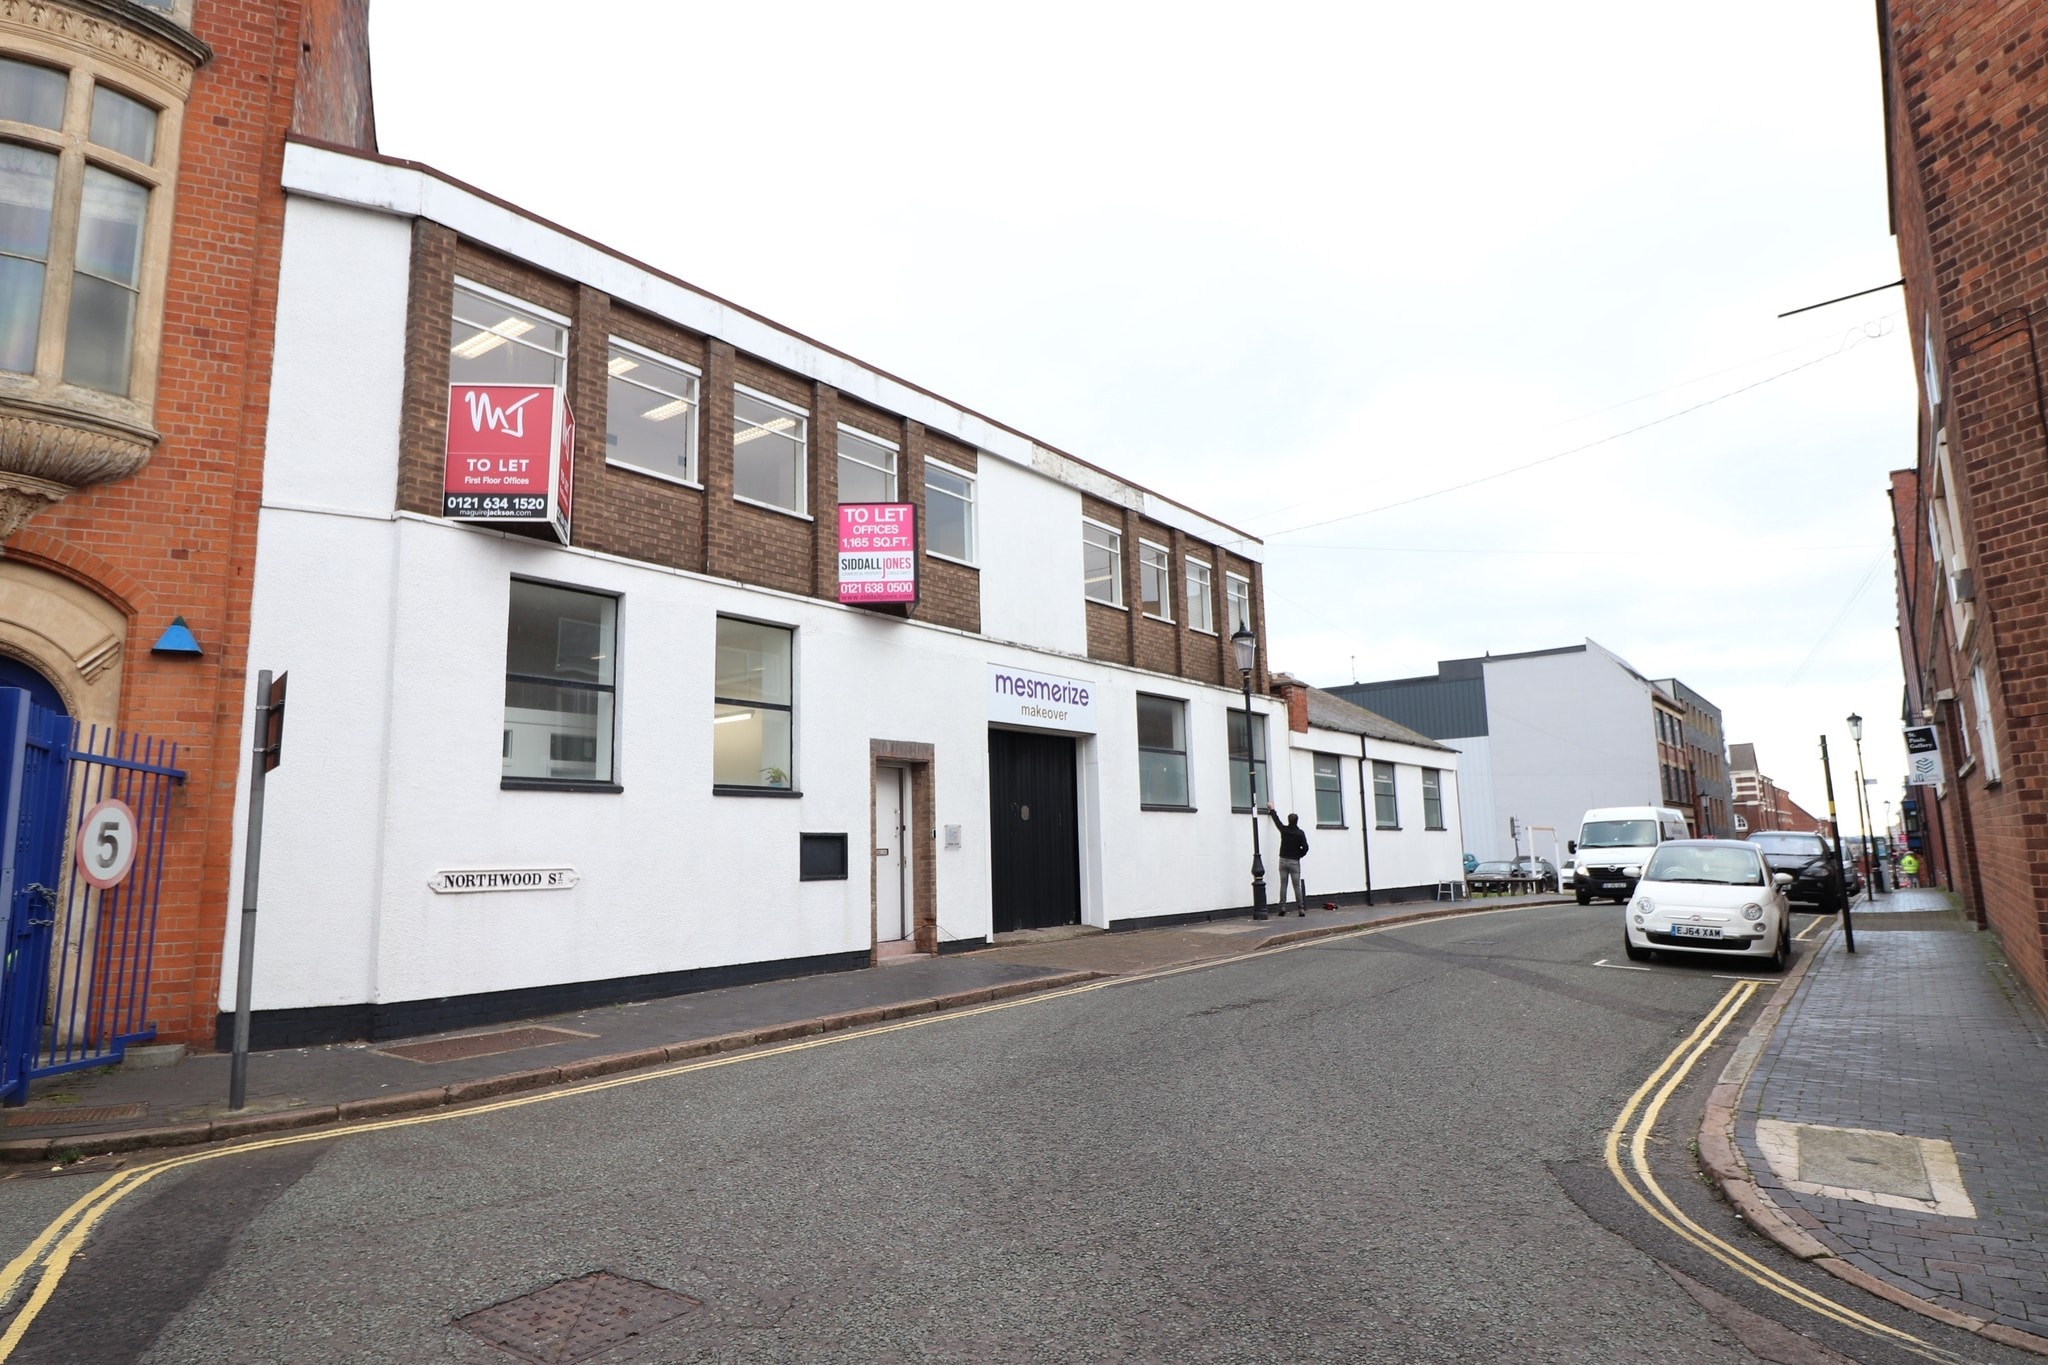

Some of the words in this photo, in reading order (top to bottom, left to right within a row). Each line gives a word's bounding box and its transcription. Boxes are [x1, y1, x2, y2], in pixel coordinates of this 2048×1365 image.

[466, 458, 491, 472] TO
[499, 459, 530, 472] LET
[464, 476, 481, 485] First
[482, 476, 501, 485] Floor
[503, 477, 530, 485] Offices
[447, 496, 478, 509] 0121
[483, 497, 508, 510] 634
[513, 498, 545, 510] 1520
[459, 509, 532, 518] maguirejackson.com
[843, 507, 869, 523] TO
[874, 507, 908, 523] LET
[853, 524, 899, 535] OFFICES
[842, 537, 869, 549] 1,165
[873, 536, 911, 548] SQ.FT.
[841, 558, 882, 571] SIDDALL
[840, 583, 862, 594] 0121
[864, 582, 884, 594] 638
[886, 582, 913, 593] 0500
[995, 673, 1089, 707] mesmerize
[1021, 704, 1068, 721] makeover
[96, 821, 120, 869] 5
[444, 872, 542, 889] NORTHWOOD
[1676, 927, 1700, 936] EJ64
[1702, 929, 1720, 937] XAM
